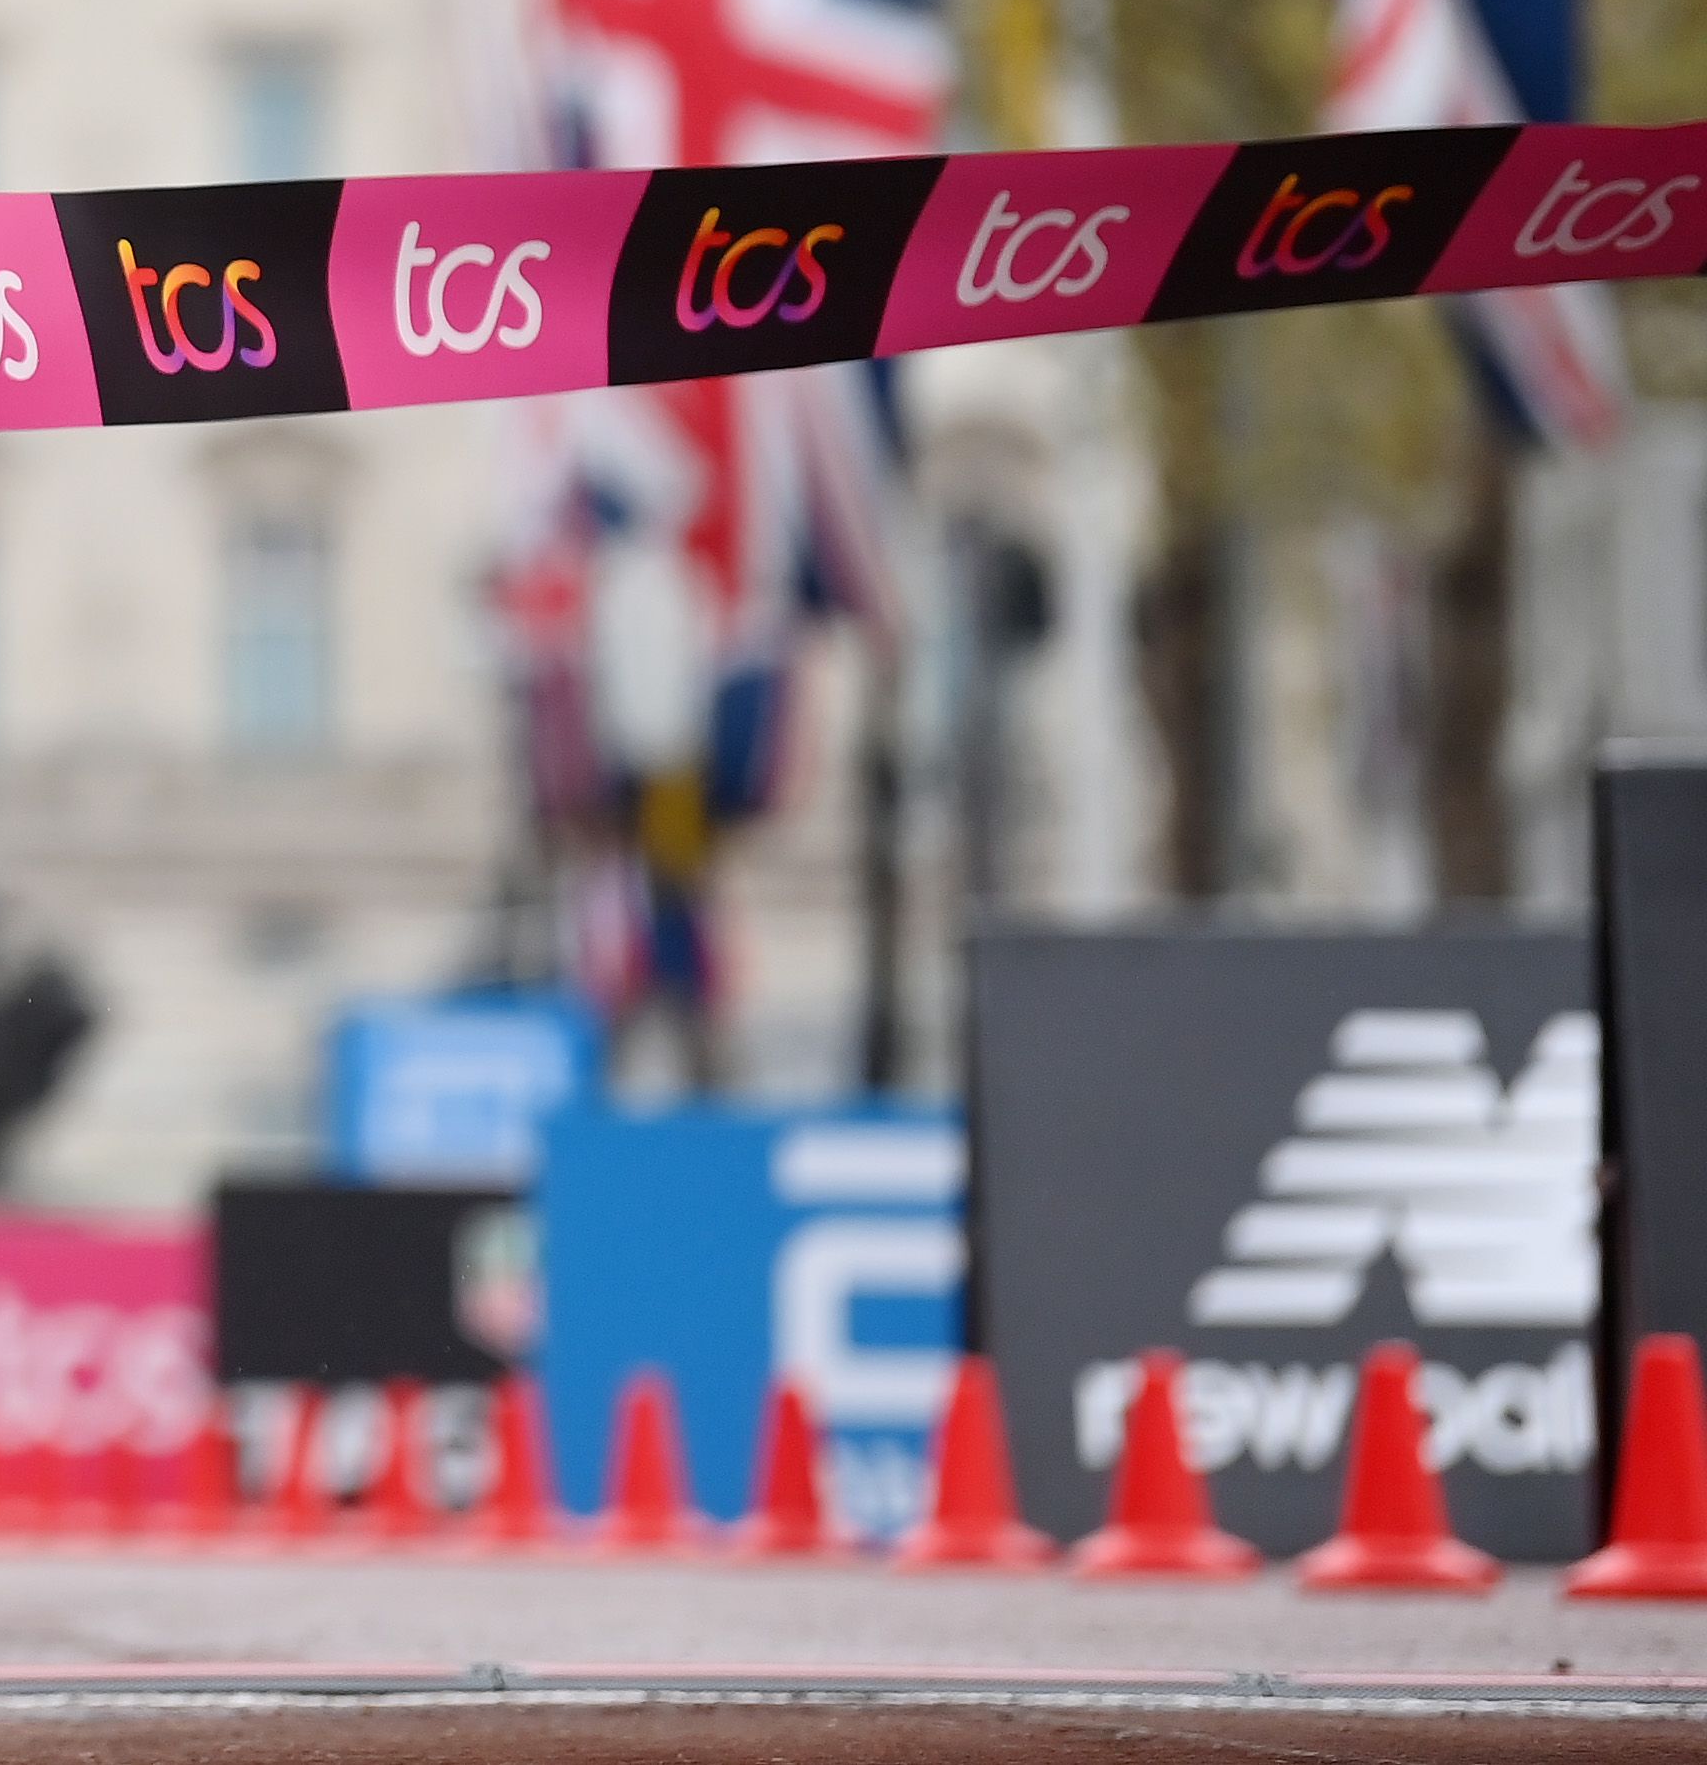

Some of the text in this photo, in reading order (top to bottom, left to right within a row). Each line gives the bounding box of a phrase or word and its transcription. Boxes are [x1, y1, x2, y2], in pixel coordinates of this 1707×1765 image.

[116, 238, 279, 375] tcs
[395, 220, 552, 356] tcs
[675, 206, 845, 332] tcs
[955, 190, 1131, 306] tcs
[1235, 172, 1415, 280] tcs
[1513, 159, 1702, 258] tcs
